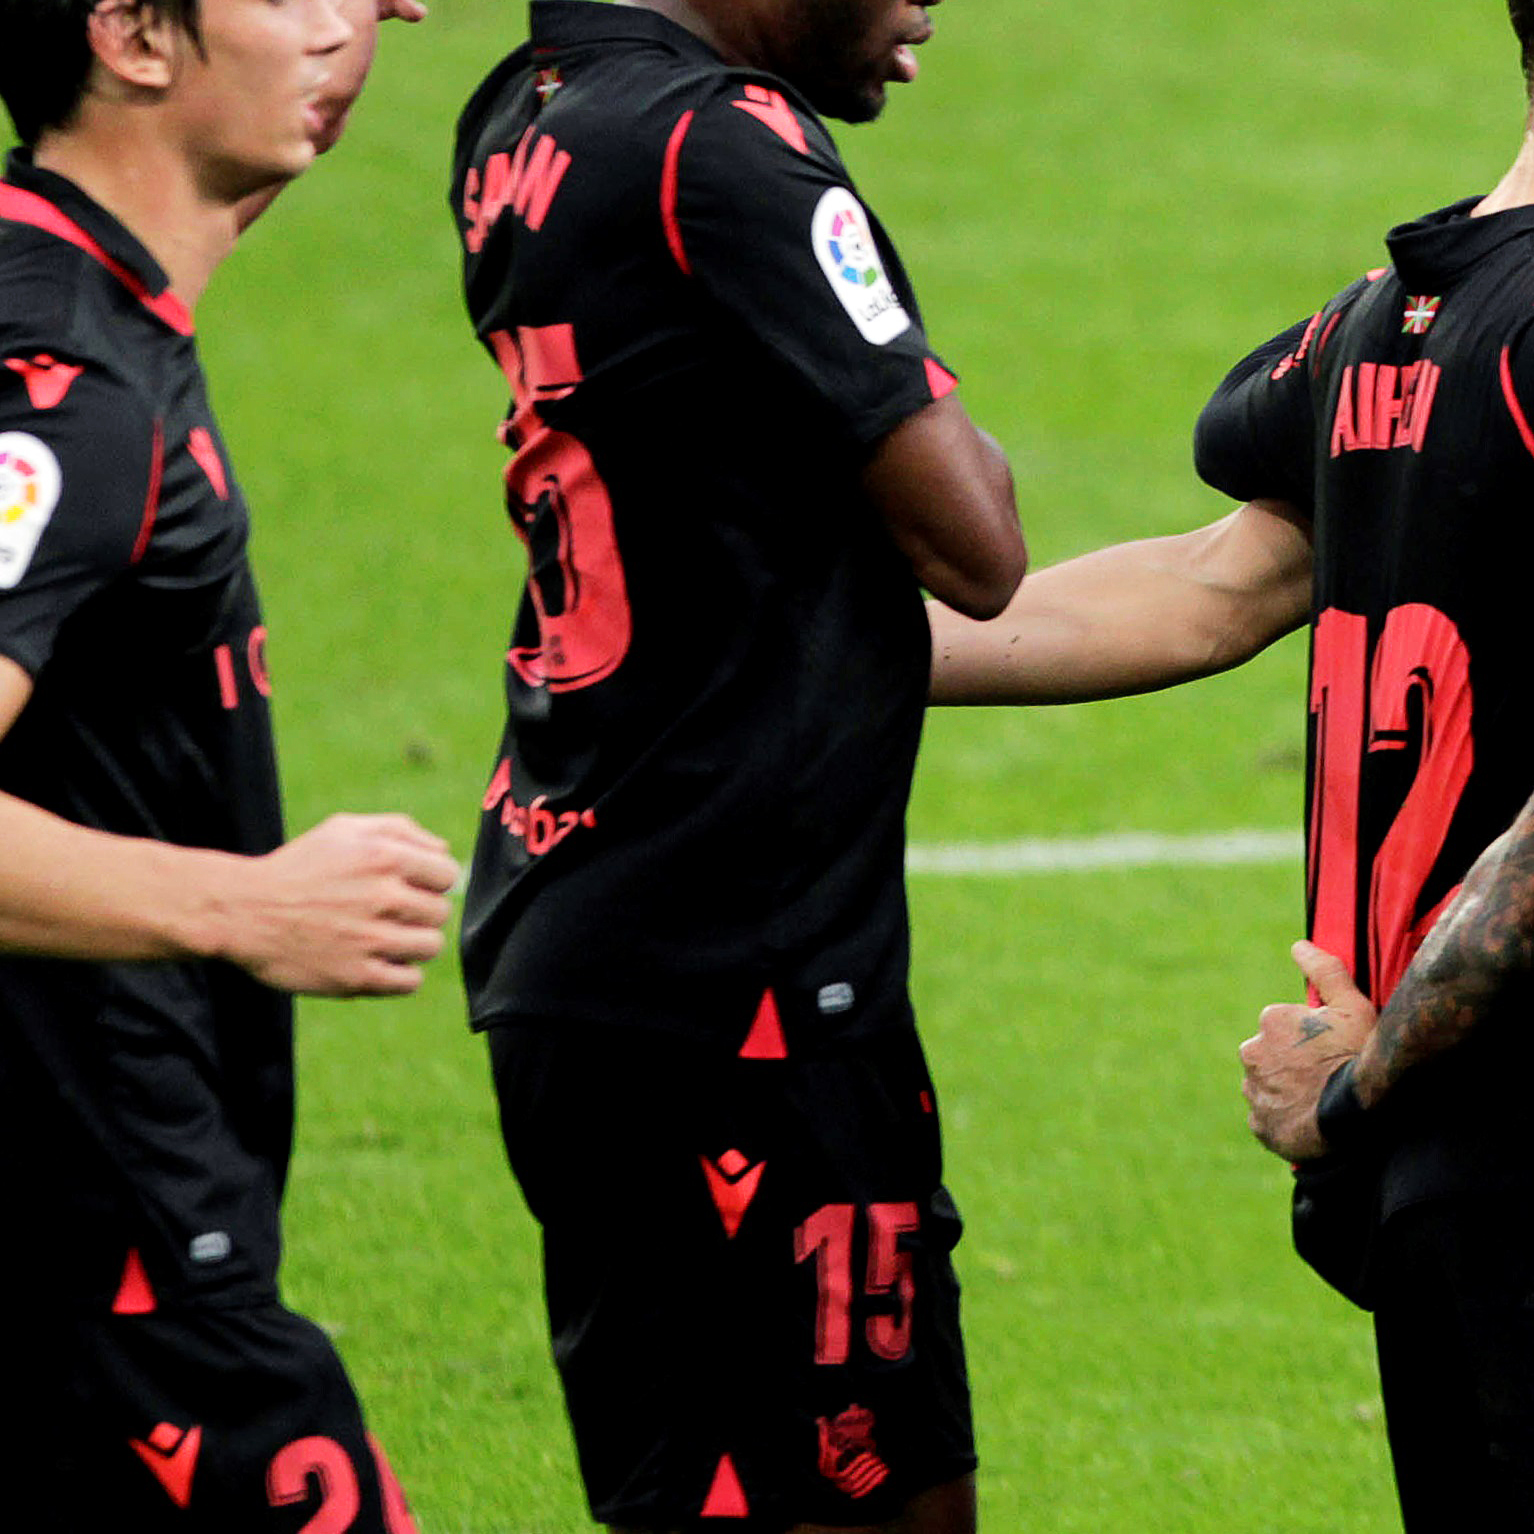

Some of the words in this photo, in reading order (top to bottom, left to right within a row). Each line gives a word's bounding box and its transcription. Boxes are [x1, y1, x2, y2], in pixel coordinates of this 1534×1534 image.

[1305, 602, 1474, 1012] 12
[793, 1202, 920, 1365] 15
[265, 1429, 420, 1534] 2
